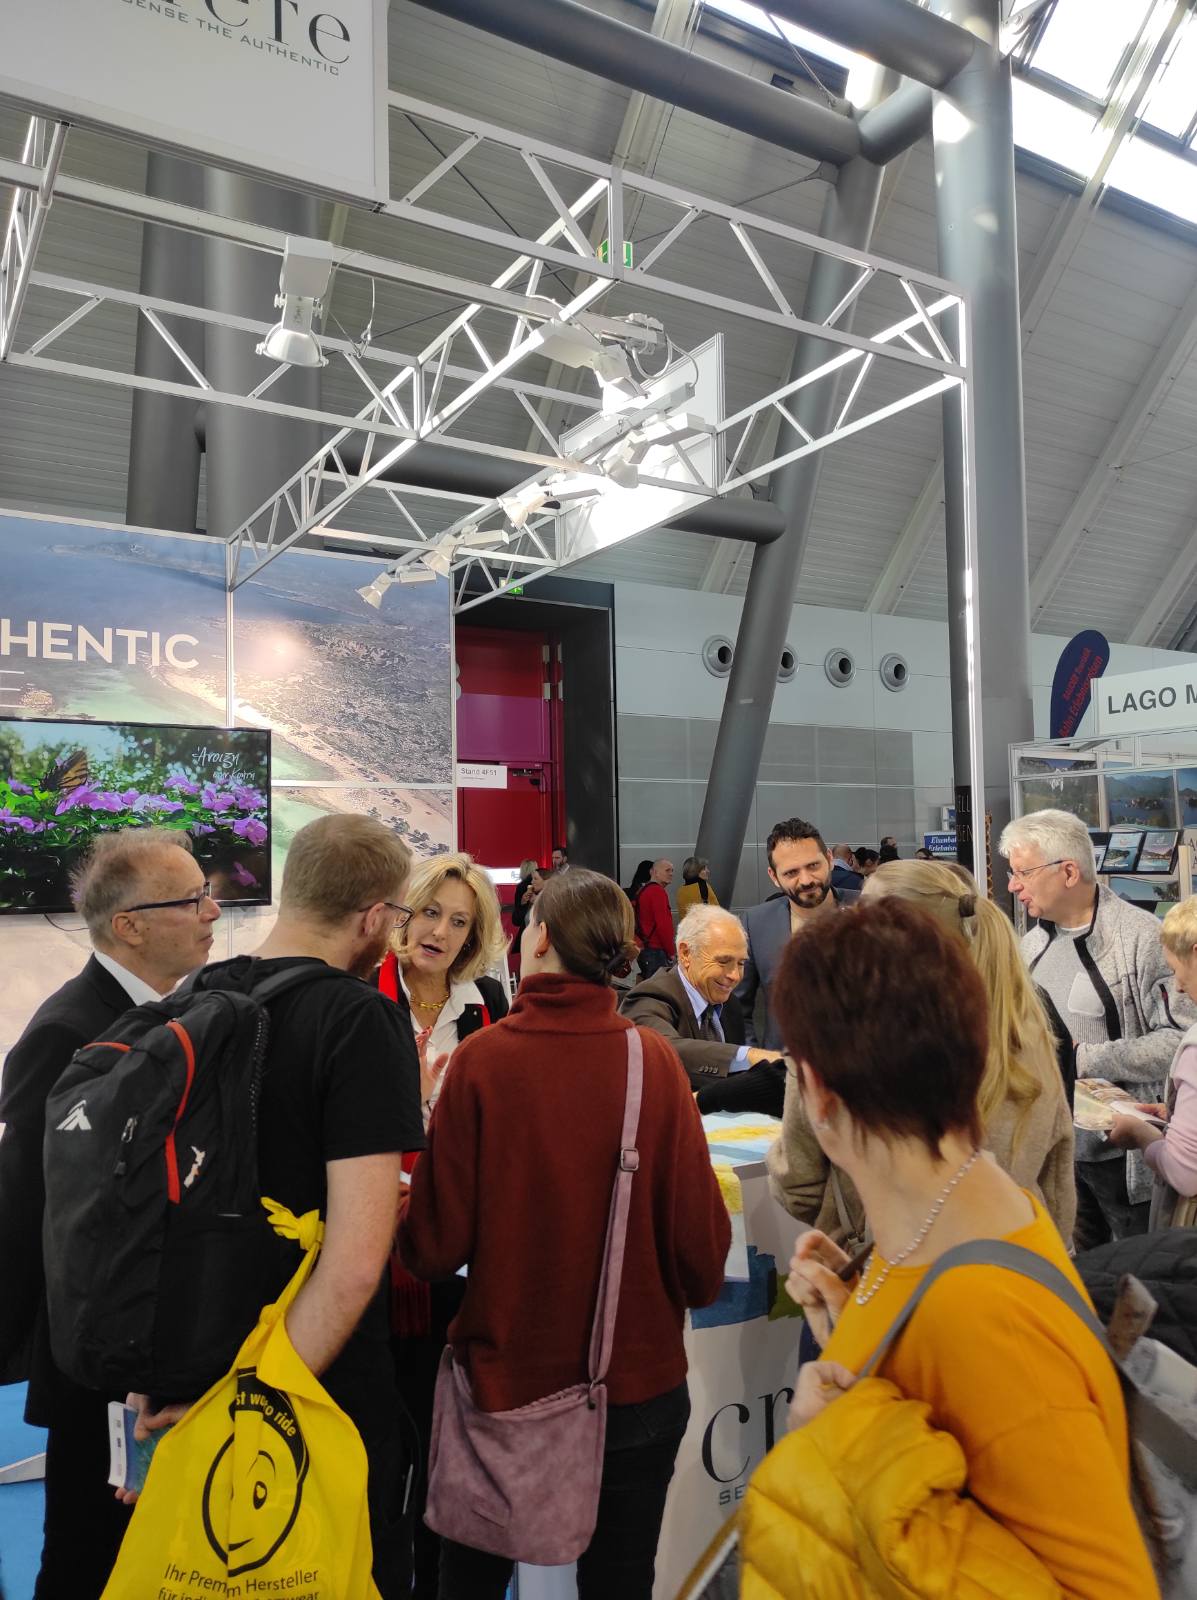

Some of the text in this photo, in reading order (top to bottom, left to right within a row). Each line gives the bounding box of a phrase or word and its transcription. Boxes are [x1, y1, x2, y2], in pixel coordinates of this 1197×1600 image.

[196, 17, 233, 39] THE
[240, 34, 340, 76] AUTHENTIC
[0, 618, 200, 670] HENTIC
[1108, 686, 1177, 714] LAGO
[460, 767, 479, 776] Stand
[273, 1412, 297, 1437] ride
[164, 1562, 186, 1583] Ihr
[245, 1568, 319, 1594] Hersteller
